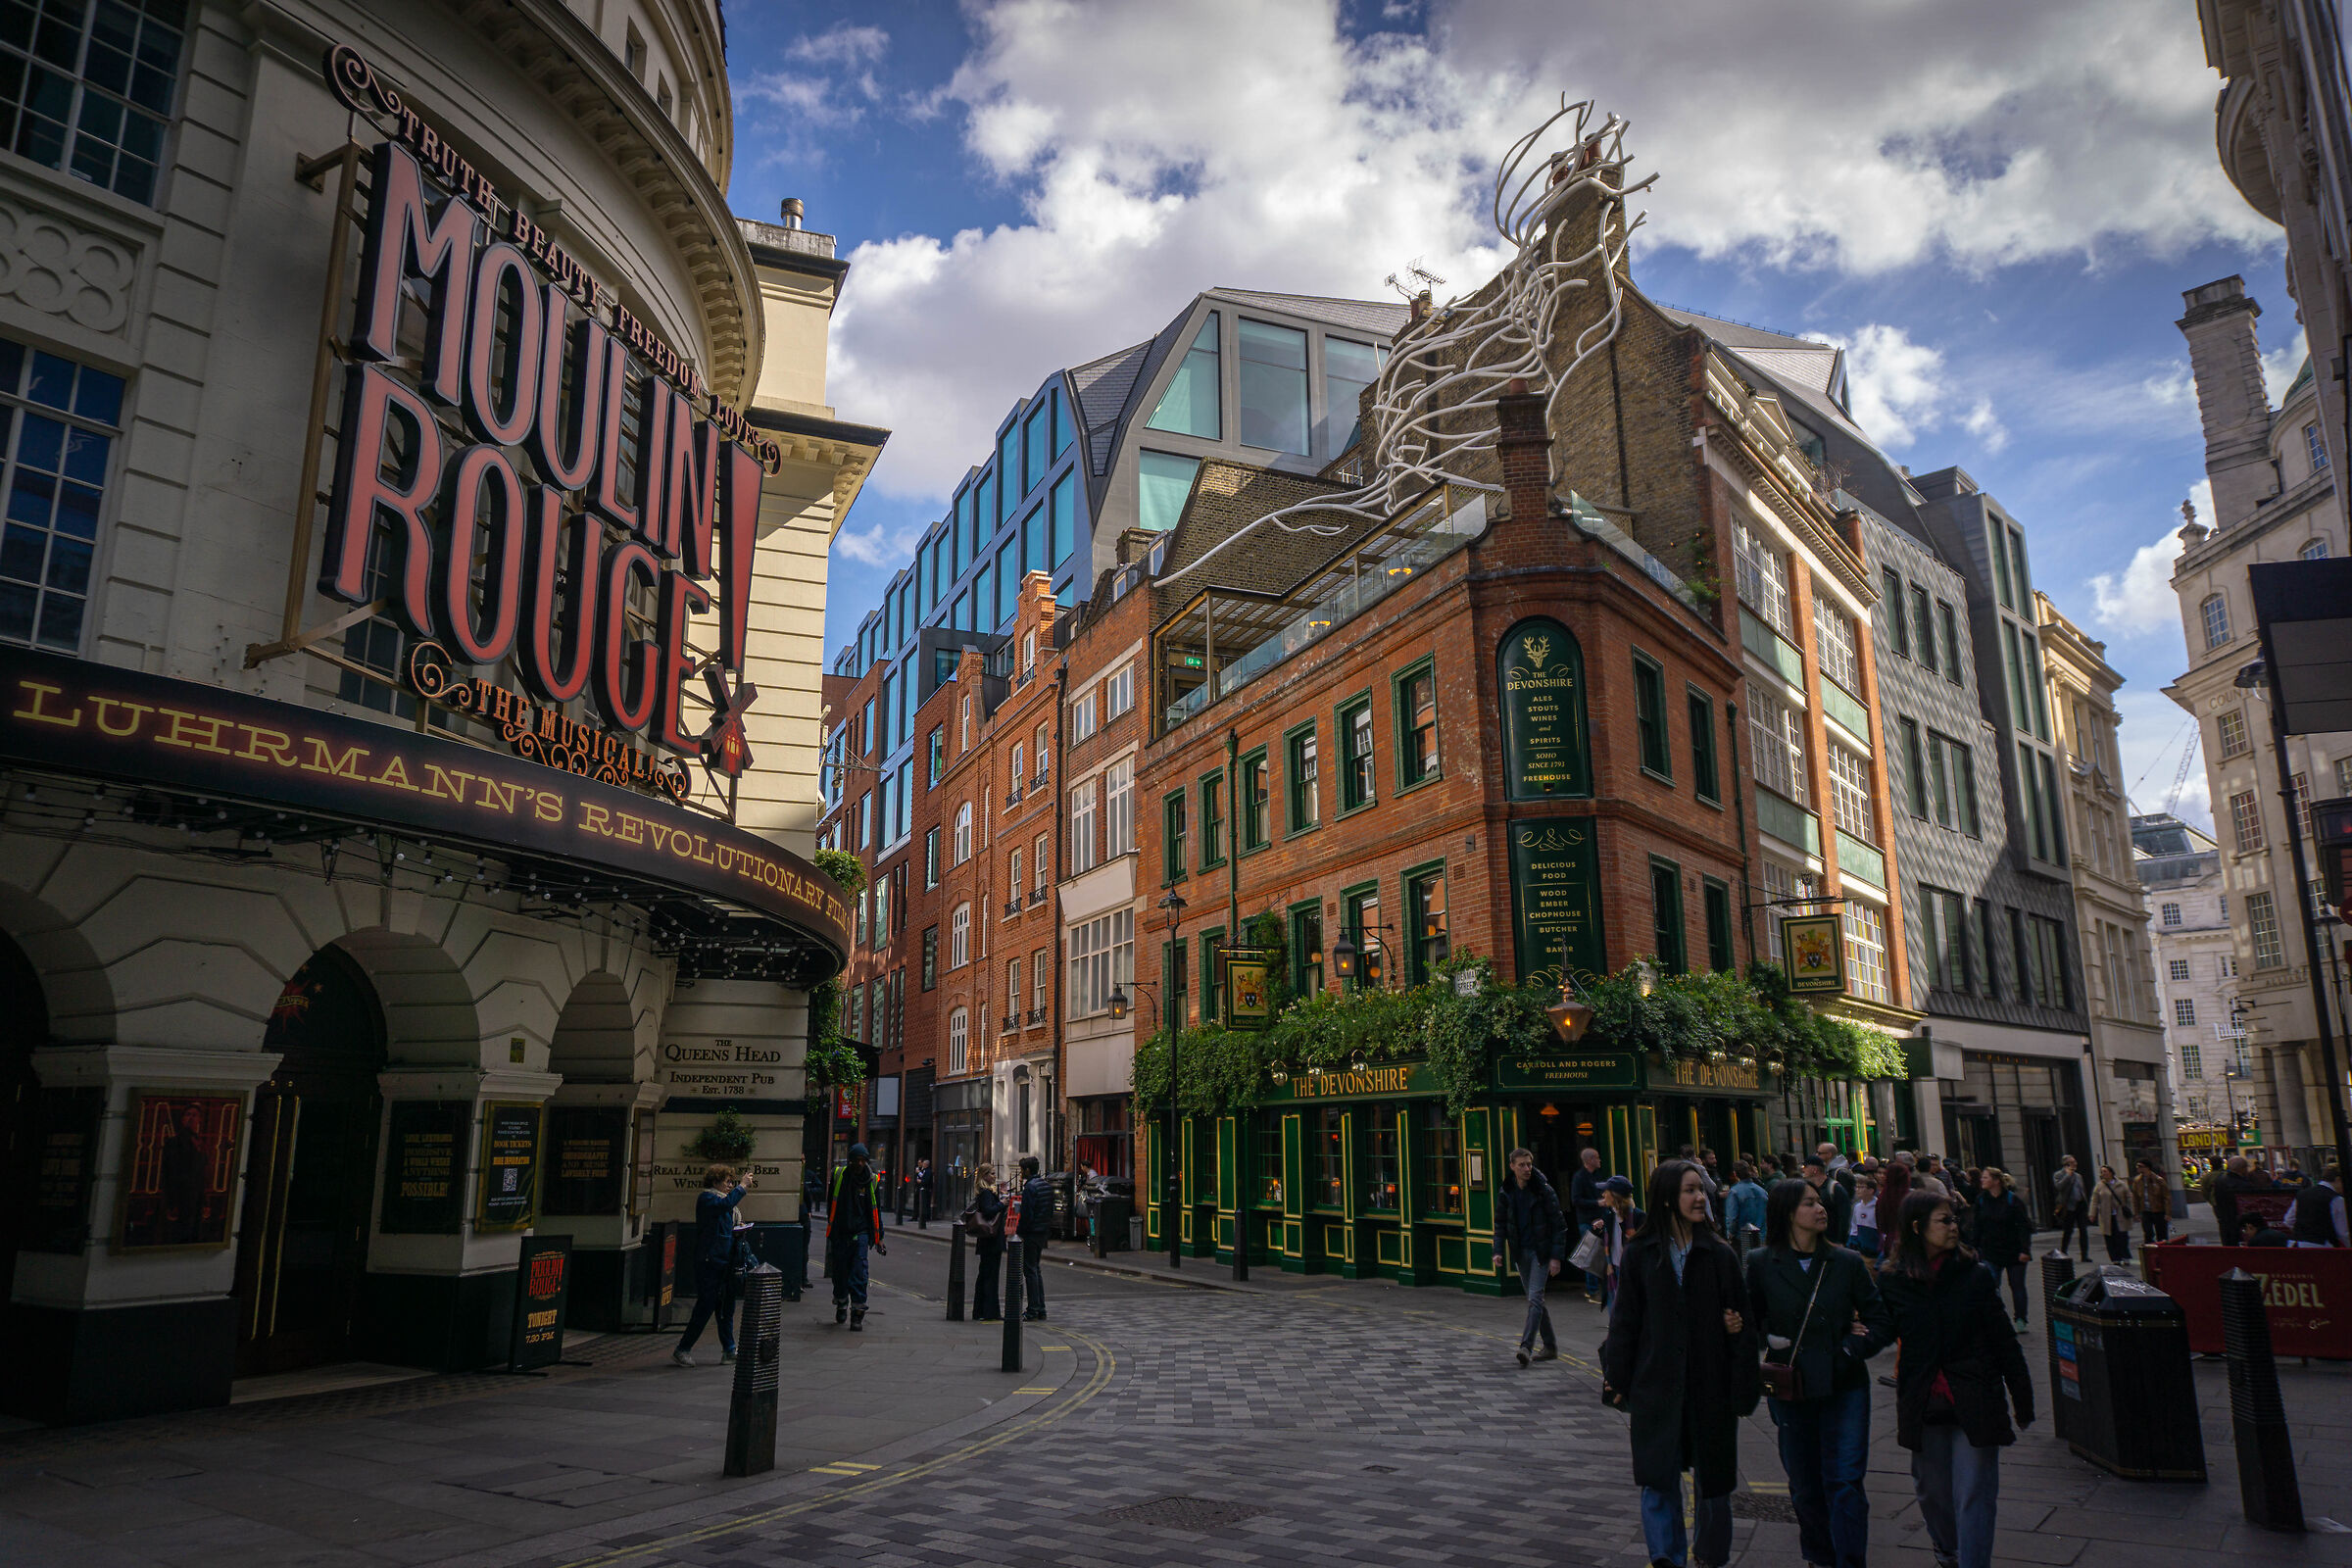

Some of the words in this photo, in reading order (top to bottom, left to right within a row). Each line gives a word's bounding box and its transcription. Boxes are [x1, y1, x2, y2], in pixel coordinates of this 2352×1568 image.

[401, 108, 494, 213] TRUTH
[512, 213, 602, 308] BEAUTY
[616, 308, 705, 399] FREEDOM
[714, 396, 758, 447] LOVE
[351, 140, 721, 582] MOULIN
[1507, 677, 1574, 691] DEVONSHIRE
[474, 677, 530, 728] THE
[537, 706, 657, 781] MUSICAL!
[1523, 773, 1572, 782] FREEHOUSE
[12, 680, 564, 823] LUHRMANN'S
[577, 801, 825, 911] REVOLUTIONARY
[1531, 861, 1577, 870] DELICIOUS
[1529, 910, 1582, 919] CHOPHOUSE
[1539, 925, 1578, 934] BUTCHER
[665, 1044, 730, 1062] QUEENS
[735, 1046, 781, 1062] HEAD
[669, 1071, 749, 1084] INDEPENDENT
[752, 1072, 775, 1085] PUB
[1292, 1077, 1316, 1099] THE
[1320, 1067, 1409, 1096] DEVONSHIRE
[1544, 1071, 1590, 1080] FREEHOUSE
[1699, 1064, 1760, 1090] DEVONSHIRE
[702, 1086, 721, 1095] EST.
[2180, 1132, 2229, 1148] LONDON
[654, 1164, 681, 1176] REAL
[754, 1164, 780, 1175] BEER
[530, 1259, 560, 1278] MOULIN
[527, 1308, 558, 1329] TONIGHT
[540, 1330, 556, 1342] PM
